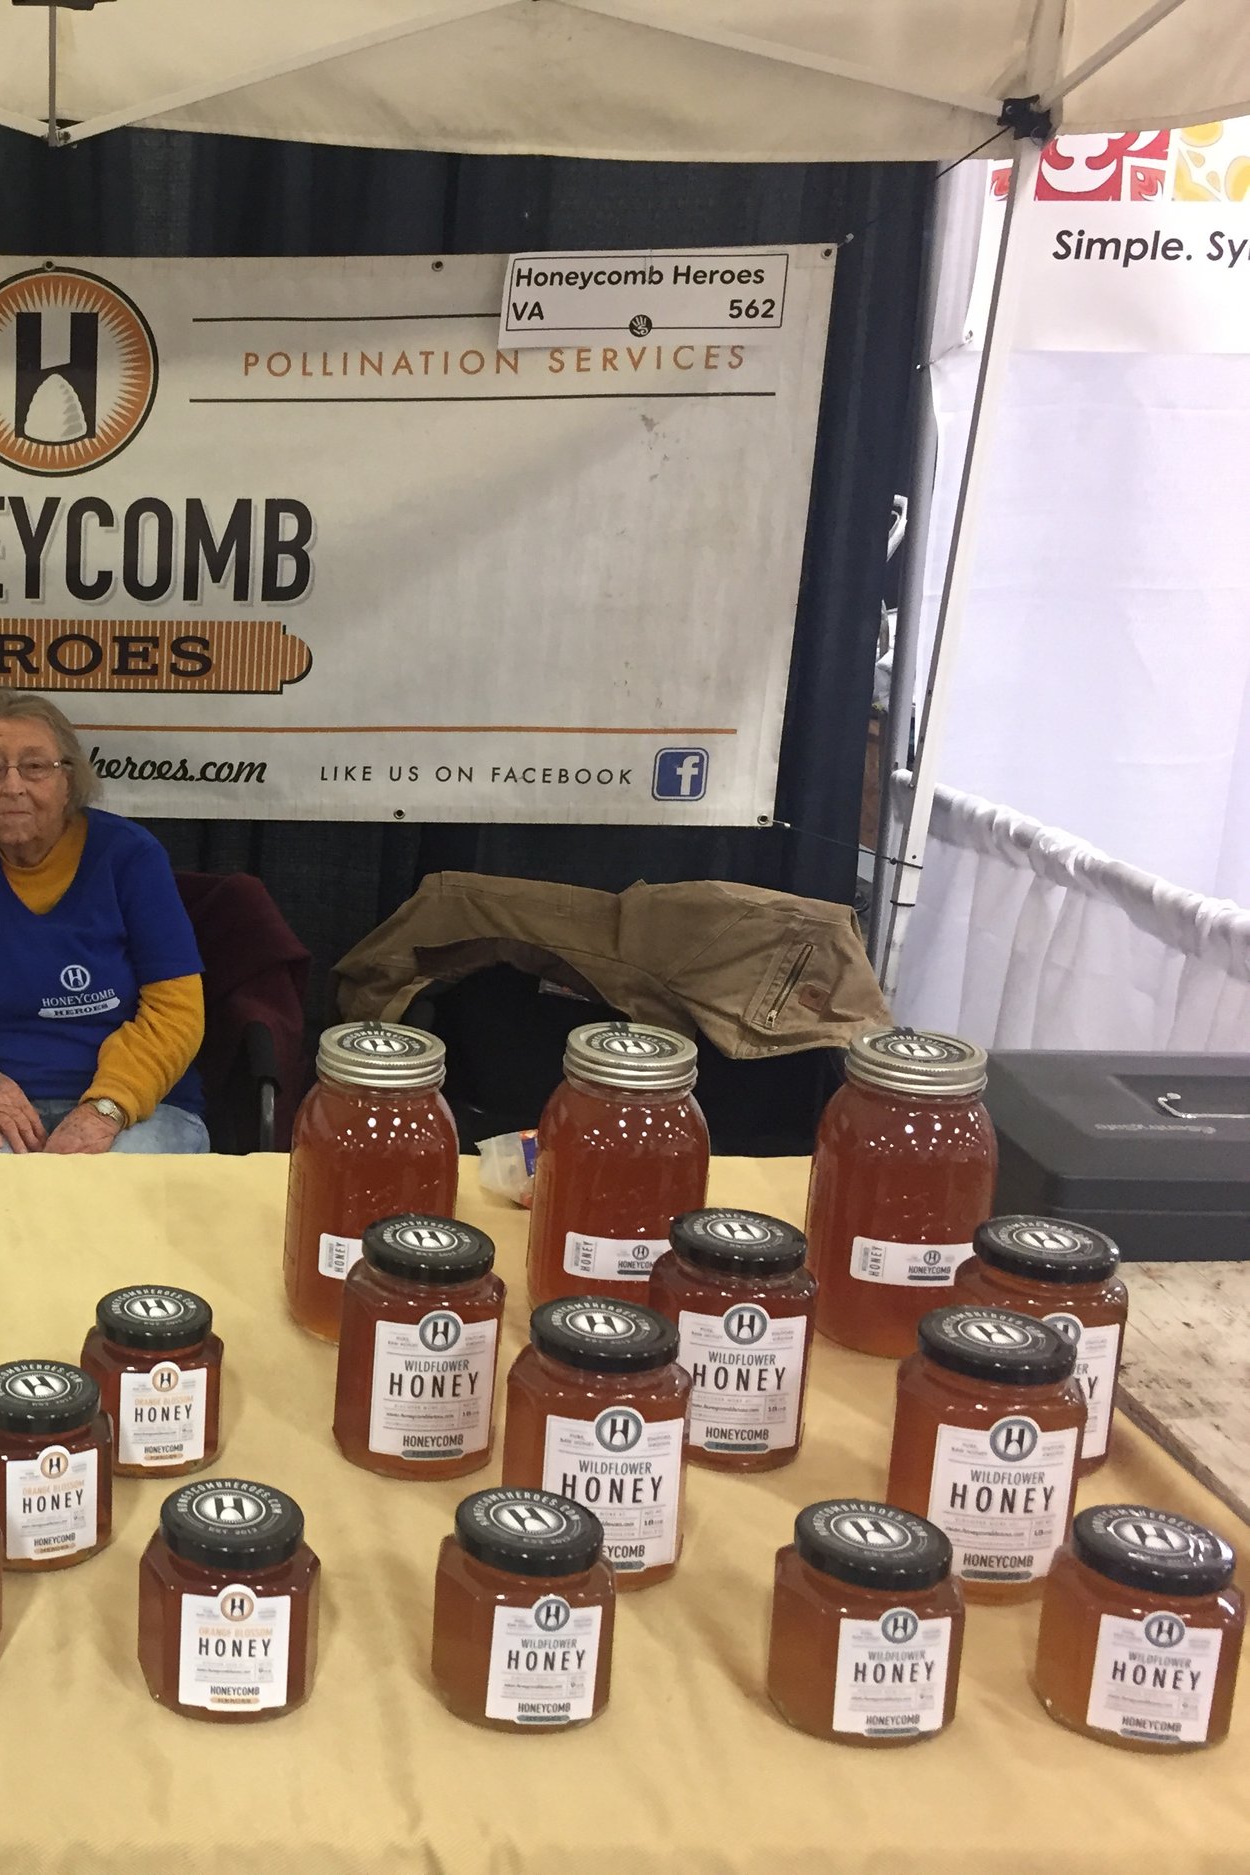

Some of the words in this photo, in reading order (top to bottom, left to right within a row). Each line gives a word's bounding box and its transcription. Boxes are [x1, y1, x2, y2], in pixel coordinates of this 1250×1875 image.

[1052, 229, 1192, 268] Simple.
[1206, 230, 1250, 269] Sy
[515, 265, 664, 290] Honeycomb
[672, 265, 765, 285] Heroes
[511, 301, 545, 321] VA
[728, 299, 776, 320] 562
[244, 348, 519, 377] POLLINATION
[548, 345, 745, 374] SERVICES
[320, 764, 373, 783] LIKE
[388, 764, 420, 784] US
[434, 765, 474, 784] ON
[490, 766, 633, 786] FACEBOOK
[42, 988, 115, 1007] HONEYCOMB
[54, 1003, 108, 1016] HEROES
[581, 1241, 594, 1272] HONEY
[868, 1246, 883, 1277] HONEY
[909, 1266, 951, 1274] HONEYCOMB
[404, 1359, 470, 1372] WILDFLOWER
[708, 1351, 776, 1366] WILDFLOWER
[388, 1371, 478, 1398] HONEY
[693, 1363, 787, 1392] HONEY
[134, 1404, 193, 1423] HONEY
[403, 1434, 464, 1448] HONEYCOMB
[705, 1426, 769, 1440] HONEYCOMB
[144, 1444, 183, 1454] HONEYCOMB
[579, 1460, 652, 1476] WILDFLOWER
[970, 1469, 1046, 1485] WILDFLOWER
[561, 1473, 663, 1504] HONEY
[22, 1489, 84, 1514] HONEY
[950, 1482, 1055, 1514] HONEY
[33, 1532, 76, 1547] HONEYCOMB
[963, 1552, 1034, 1568] HONEYCOMB
[198, 1637, 271, 1658] HONEY
[521, 1639, 577, 1649] WILDFLOWER
[507, 1650, 586, 1671] HONEY
[868, 1650, 926, 1661] WILDFLOWER
[1129, 1652, 1192, 1667] WILDFLOWER
[853, 1661, 935, 1683] HONEY
[1111, 1660, 1201, 1690] HONEY
[210, 1685, 260, 1696] HONEYCOMB
[518, 1702, 571, 1714] HONEYCOMB
[866, 1714, 920, 1726] HONEYCOMB
[1122, 1715, 1182, 1732] HONEYCOMB
